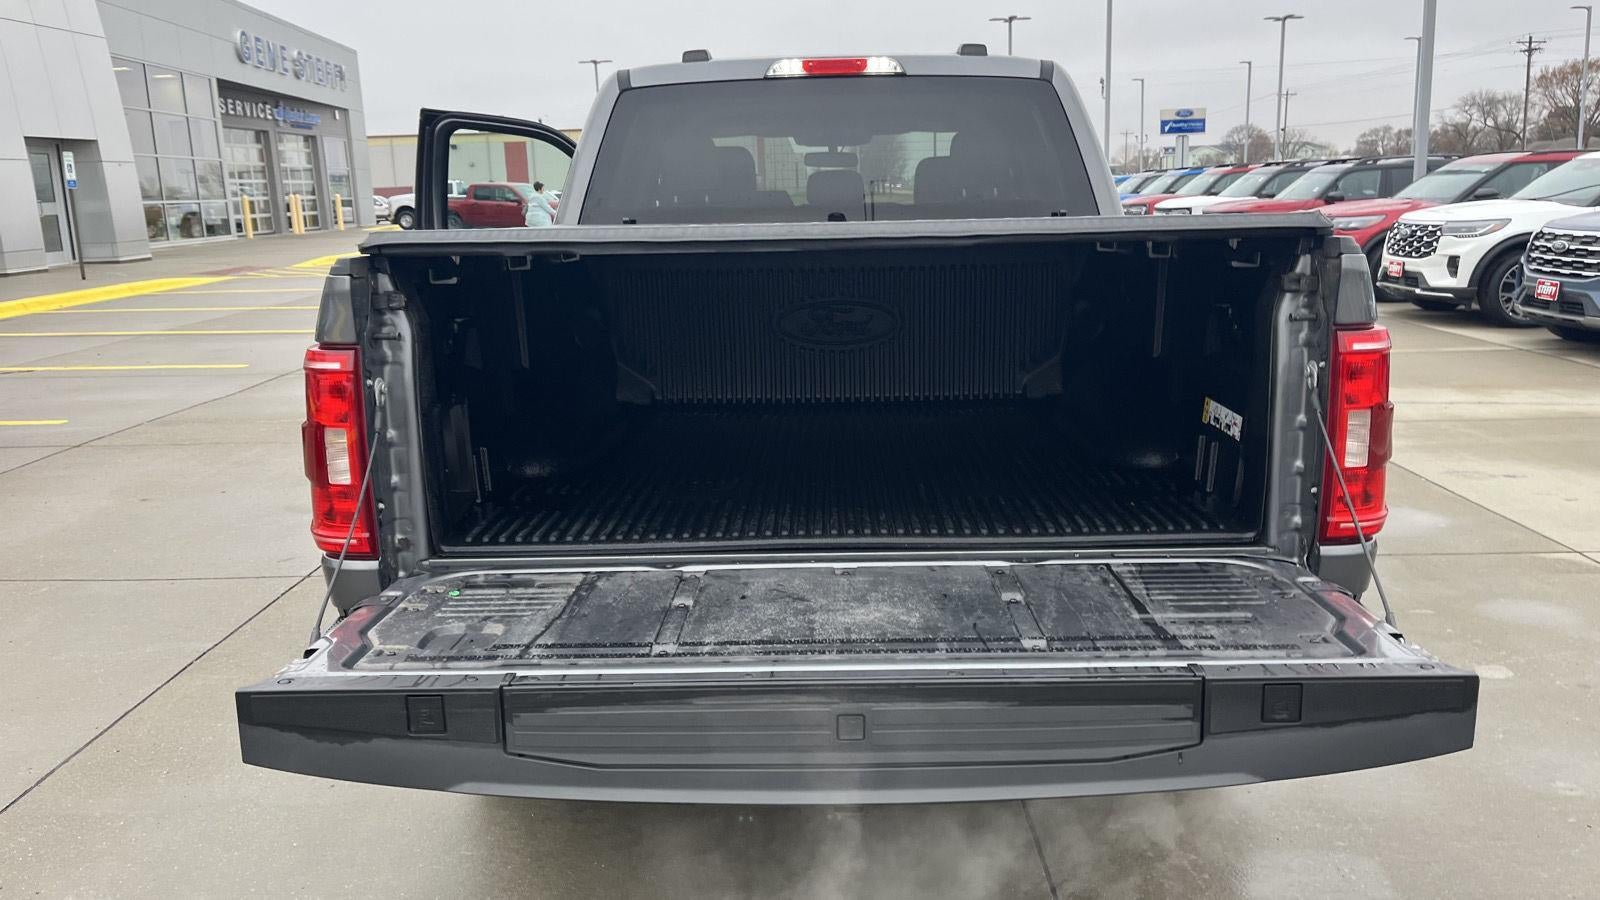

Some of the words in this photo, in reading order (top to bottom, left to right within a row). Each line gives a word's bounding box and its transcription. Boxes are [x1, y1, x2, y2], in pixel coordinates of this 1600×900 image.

[236, 29, 289, 76] GENE
[218, 97, 273, 120] SERVICE
[1536, 284, 1557, 296] STEFFY
